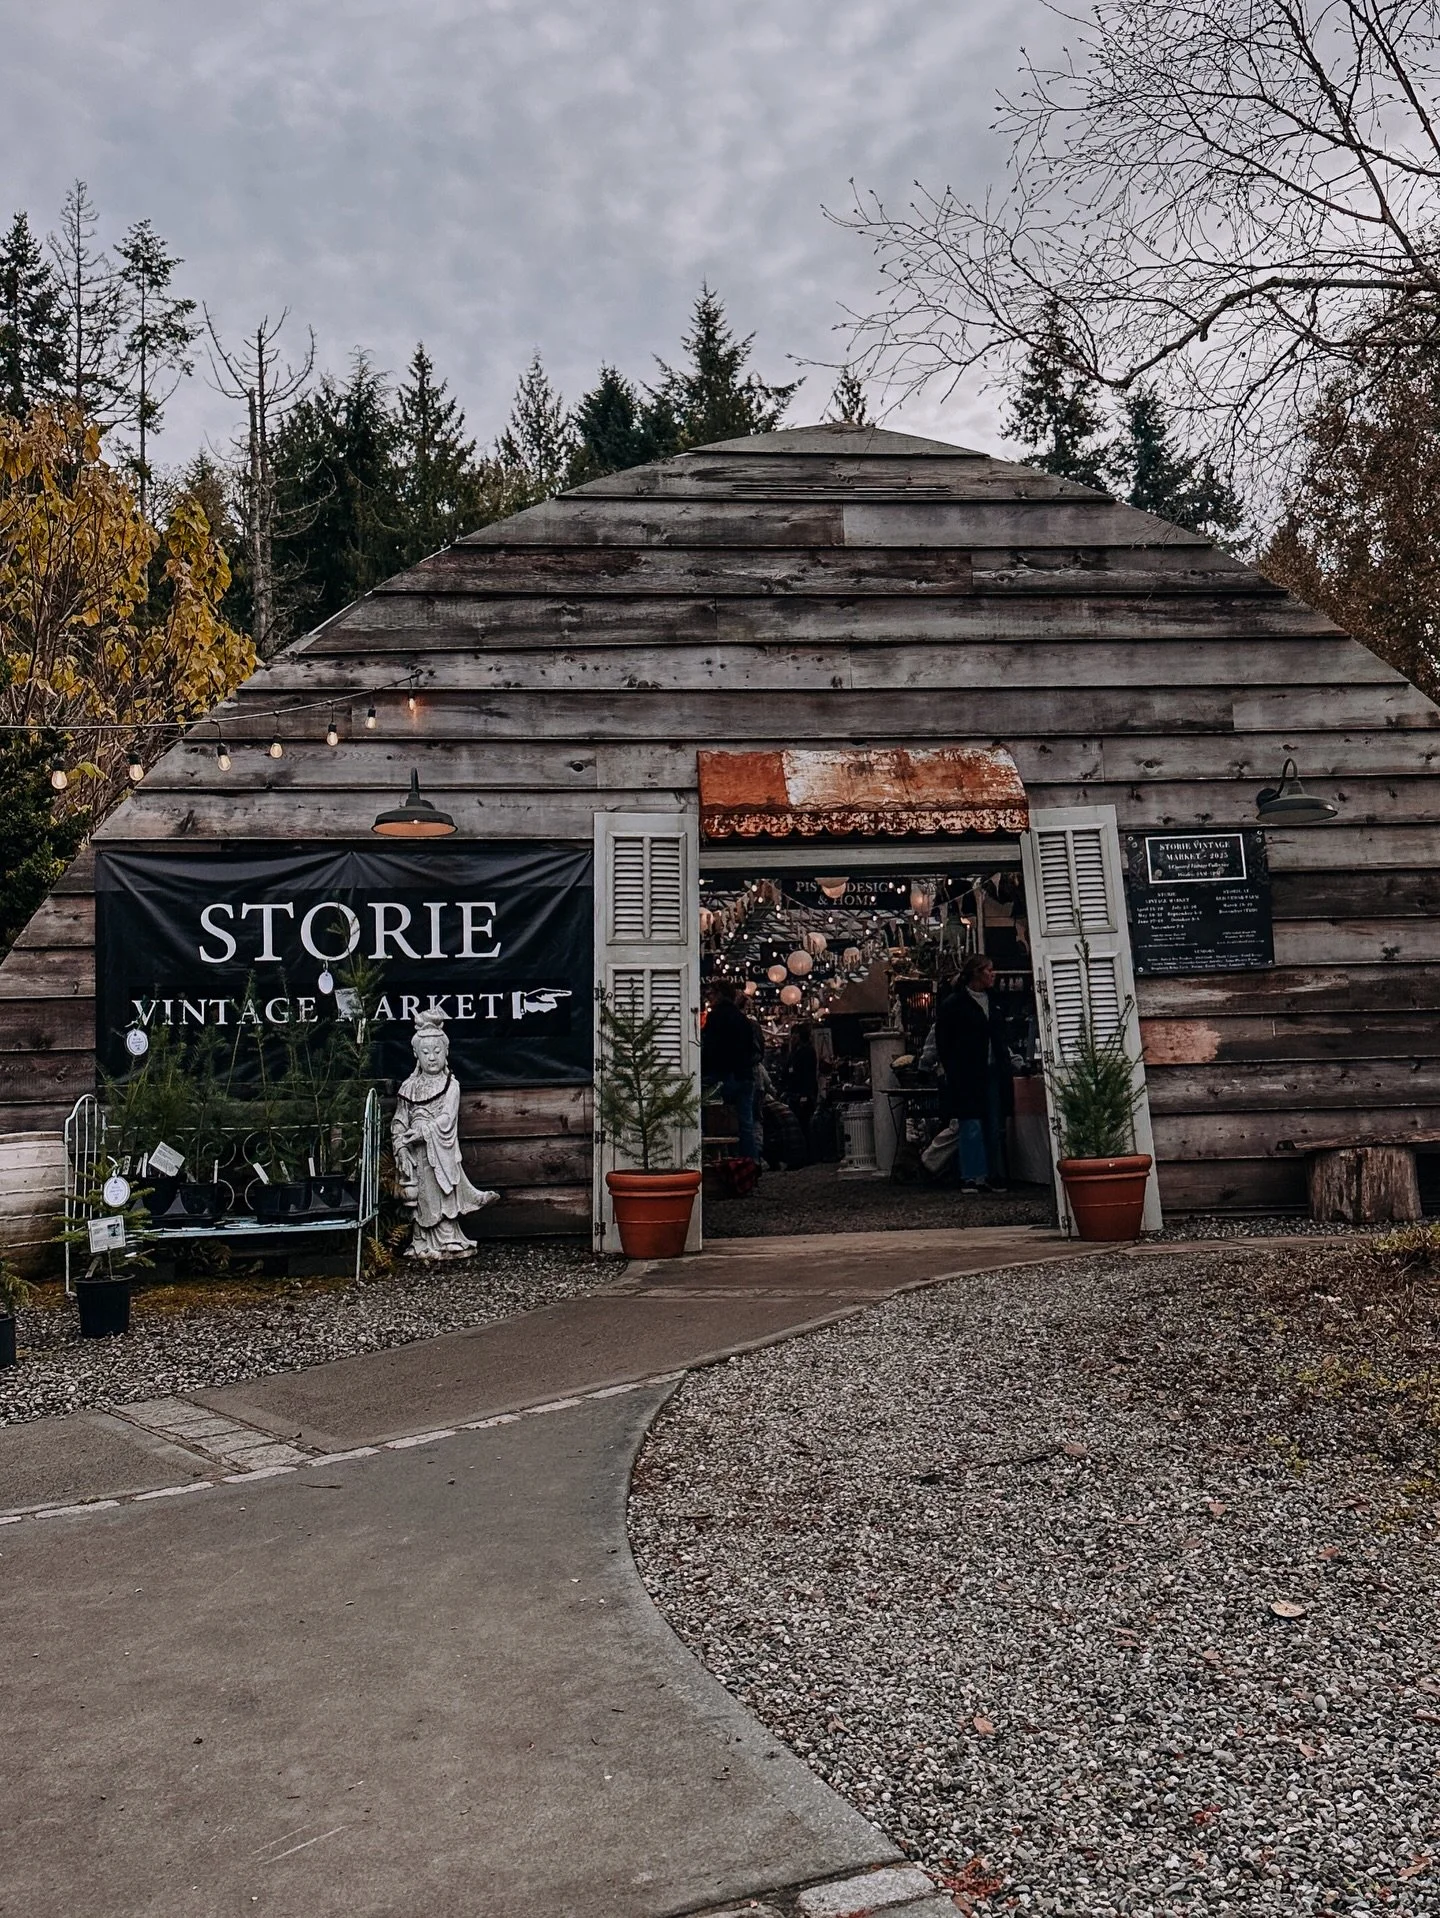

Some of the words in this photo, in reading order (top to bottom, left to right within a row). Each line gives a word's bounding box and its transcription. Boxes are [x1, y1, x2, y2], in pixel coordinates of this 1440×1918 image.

[1160, 843, 1191, 851] STORIE
[1193, 841, 1230, 849] VINTAGE
[1166, 852, 1200, 861] MARKET
[1209, 851, 1229, 860] 2025
[846, 882, 896, 893] DESIG
[817, 895, 828, 906] &
[199, 901, 502, 963] STORIE
[131, 997, 319, 1026] VINTAGE
[335, 993, 504, 1022] ARKET
